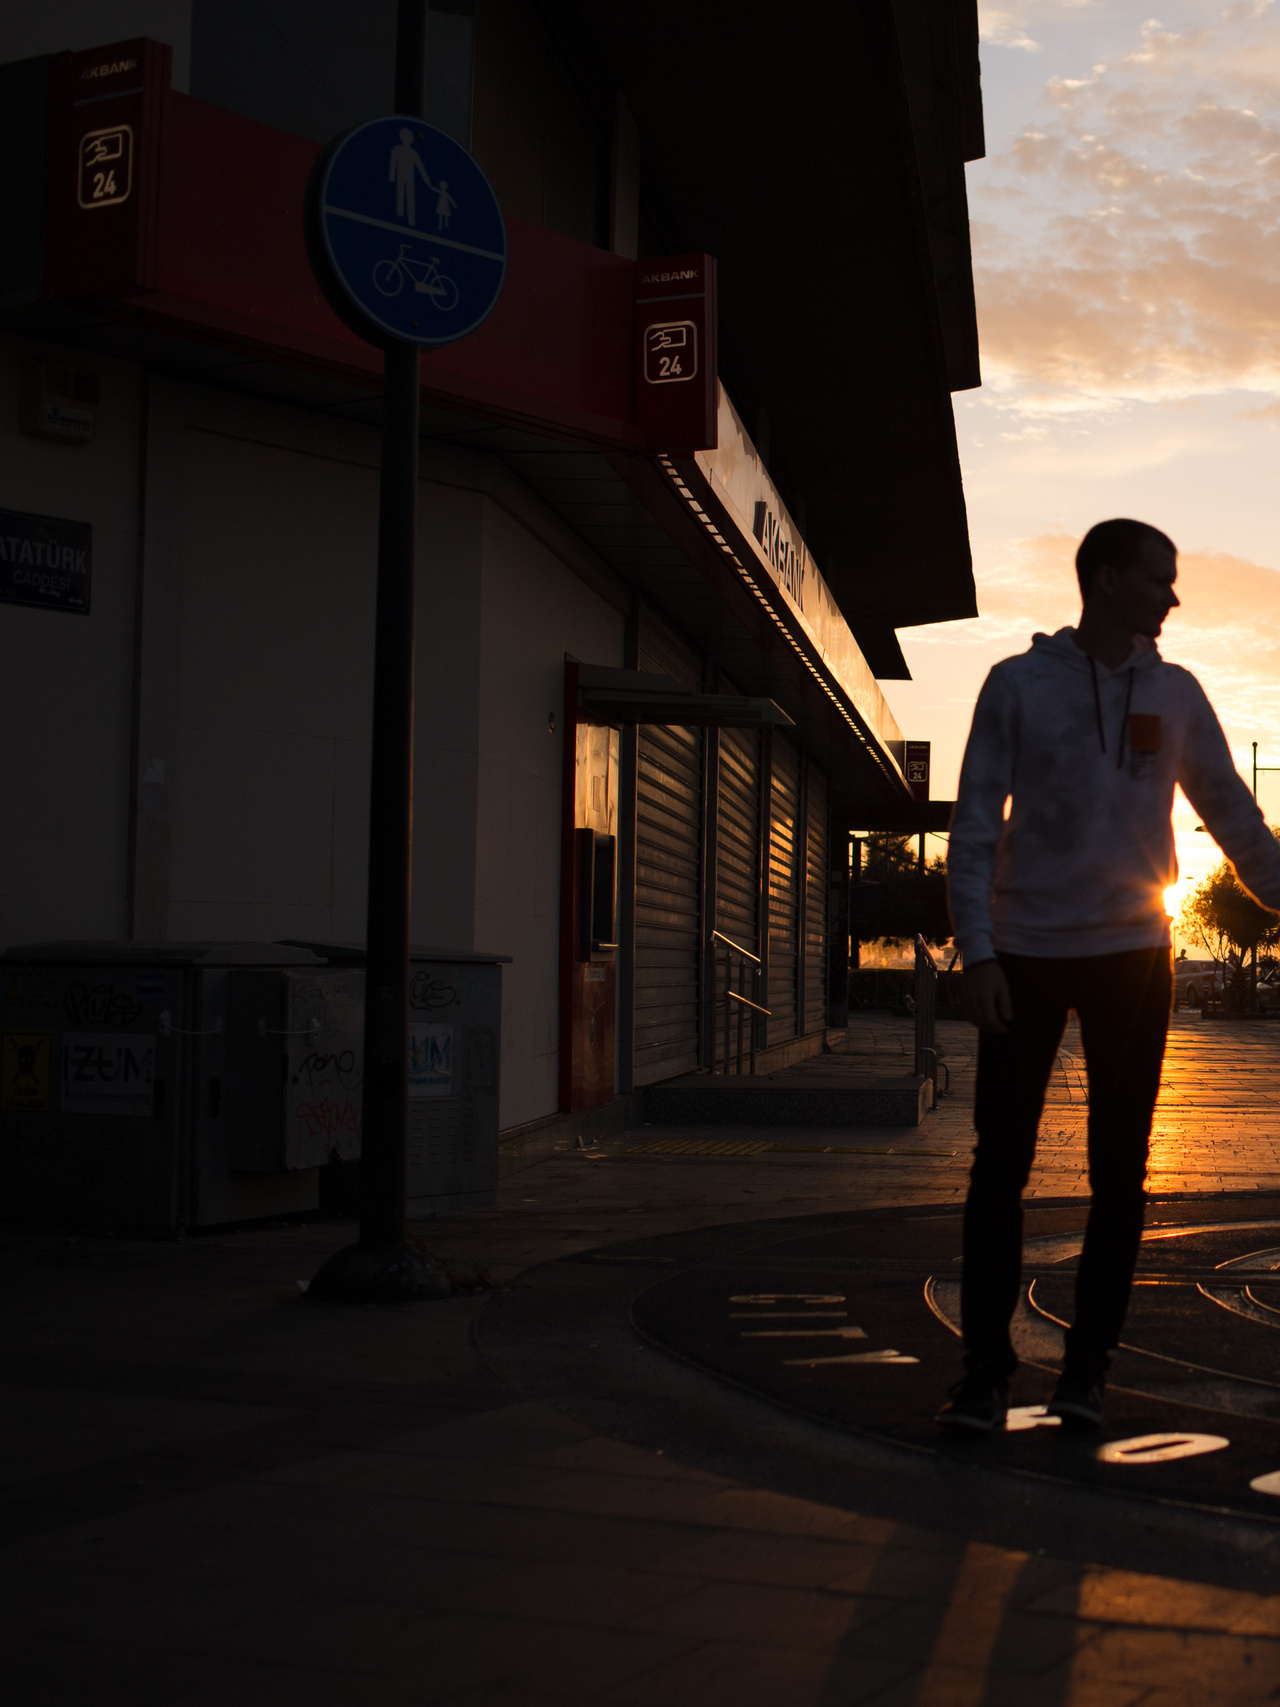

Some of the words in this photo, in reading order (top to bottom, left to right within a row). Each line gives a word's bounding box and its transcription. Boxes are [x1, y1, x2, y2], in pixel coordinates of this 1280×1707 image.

[81, 58, 139, 81] AKBANK
[92, 171, 118, 200] 24
[641, 268, 699, 285] AKBANK
[658, 354, 684, 378] 24
[753, 500, 807, 614] AKBANK
[12, 569, 72, 591] CADDESİ
[912, 771, 923, 781] 24
[408, 1035, 450, 1074] UM
